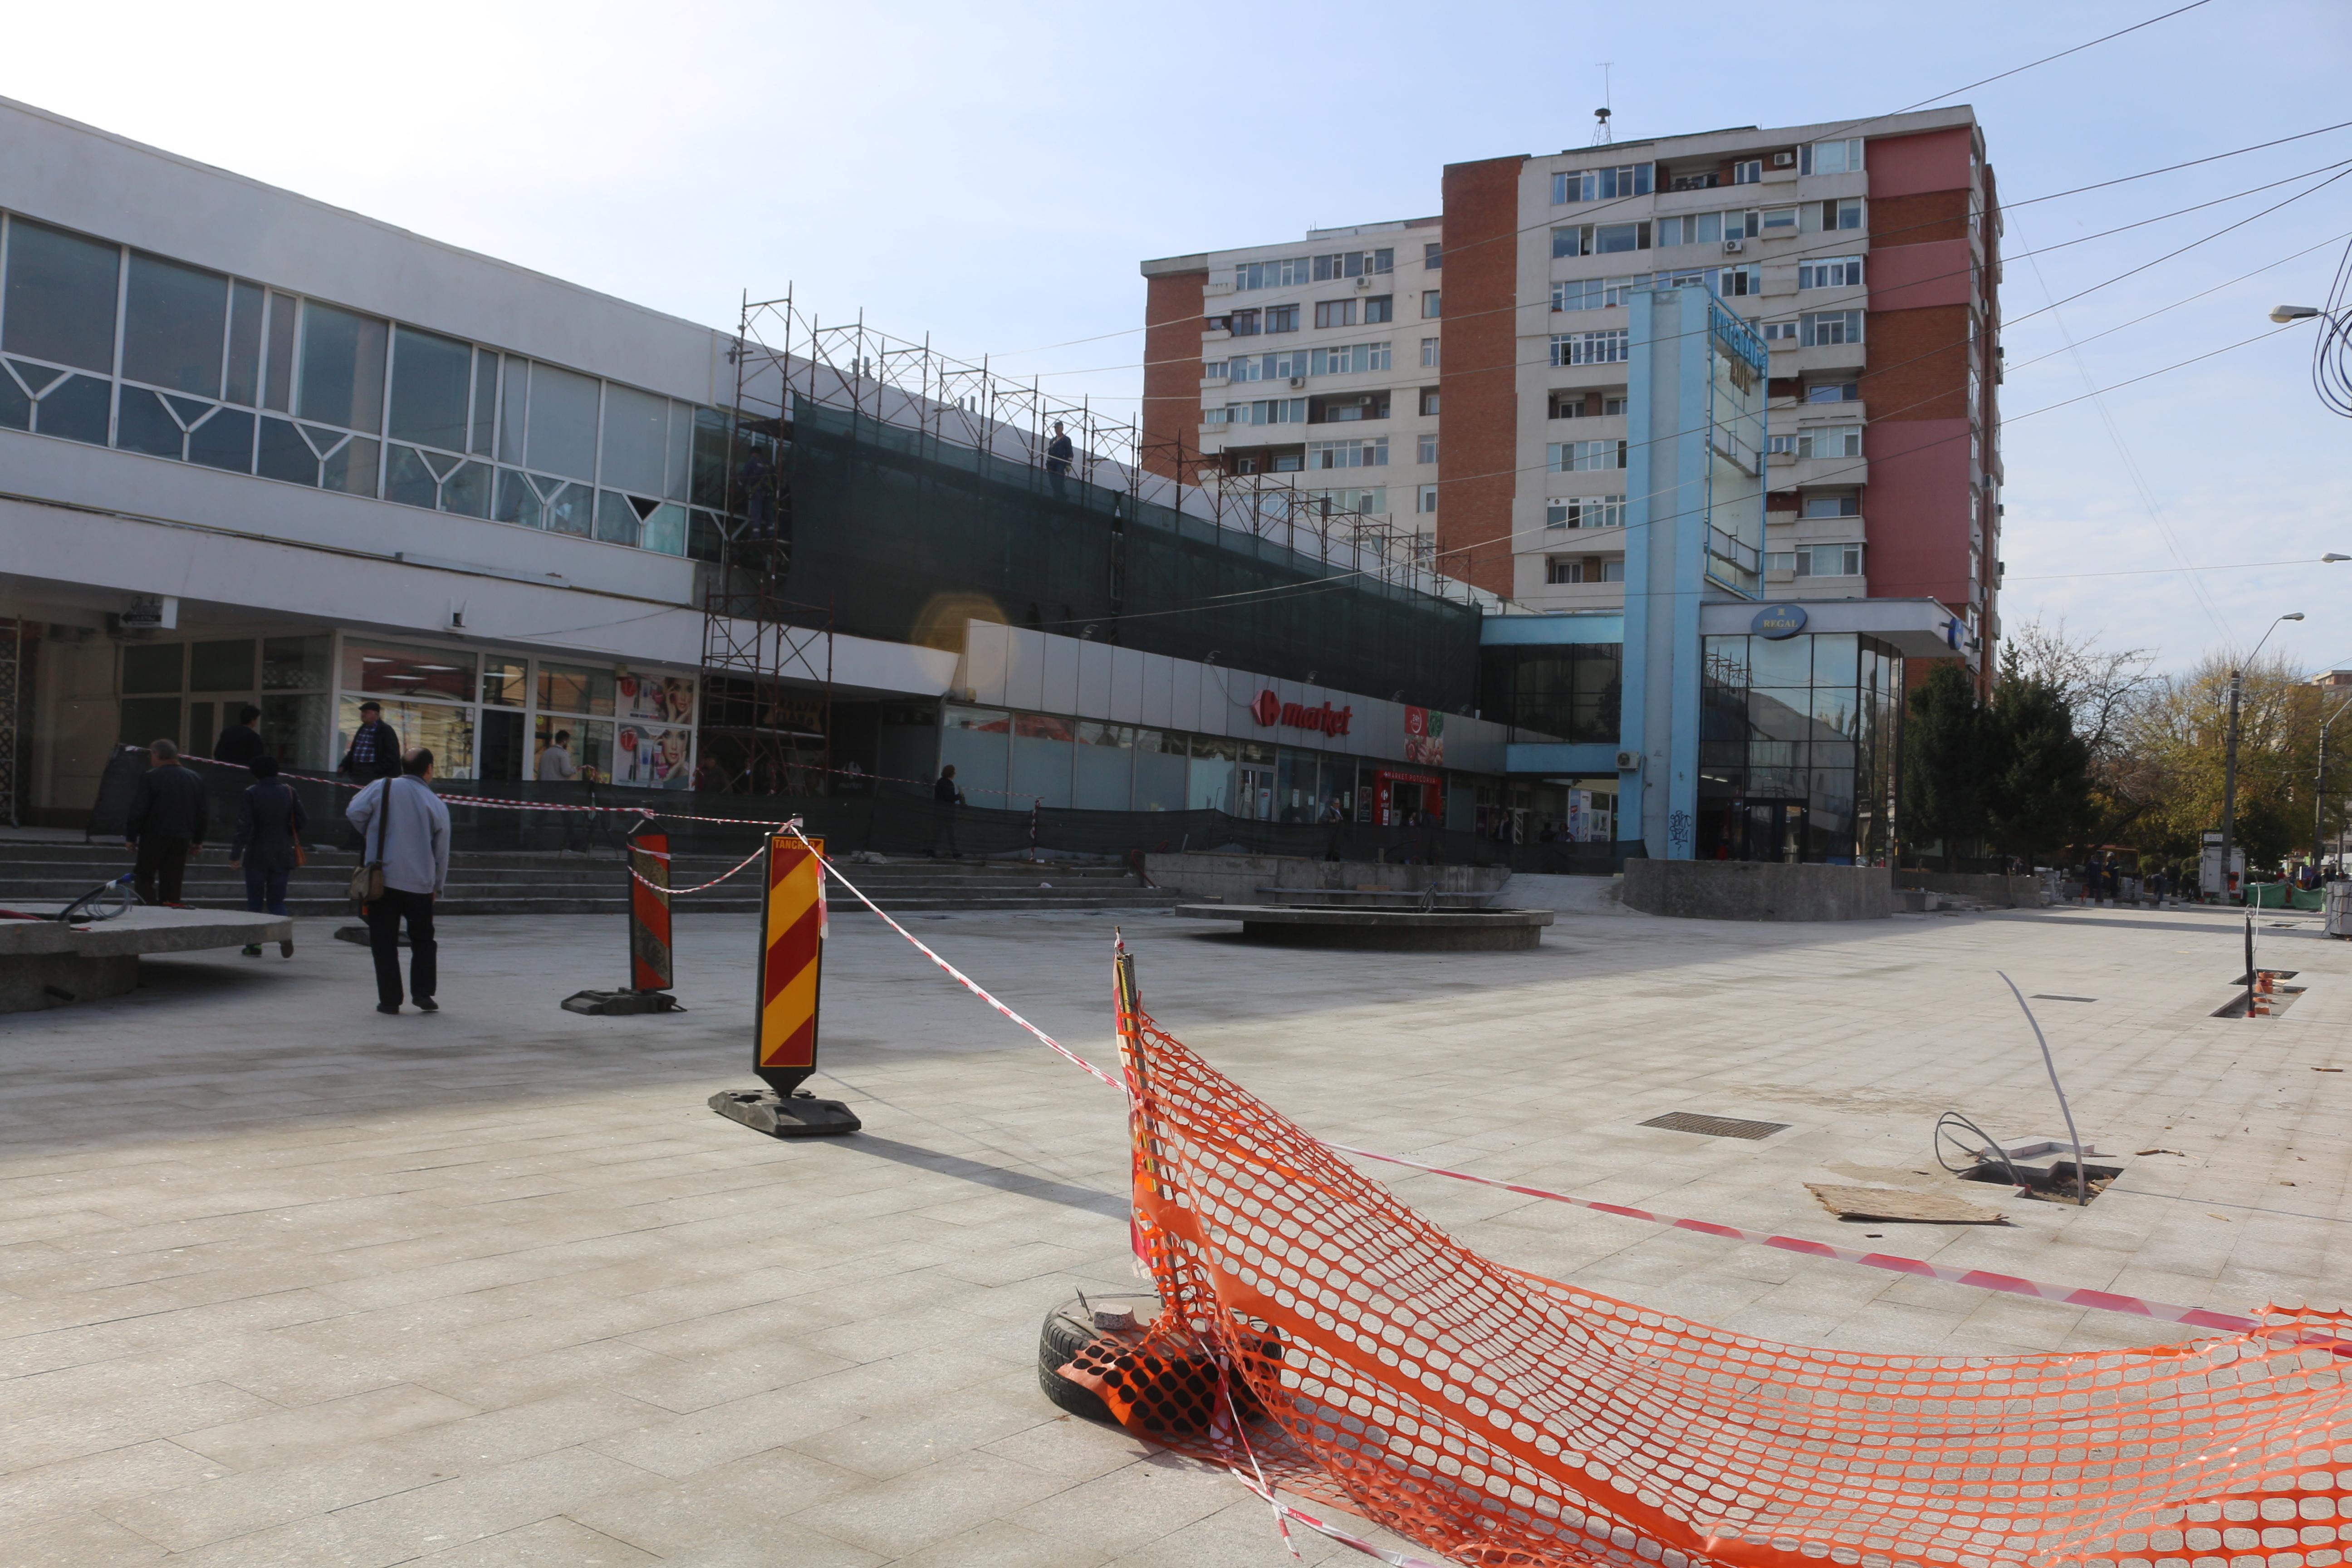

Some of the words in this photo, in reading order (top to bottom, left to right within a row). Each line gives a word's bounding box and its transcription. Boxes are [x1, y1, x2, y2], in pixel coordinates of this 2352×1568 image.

[1730, 358, 1750, 397] AUR
[1764, 619, 1798, 627] REGAL
[1281, 701, 1353, 737] market
[1387, 771, 1408, 780] MARKET
[1409, 774, 1436, 783] POTCOAVA
